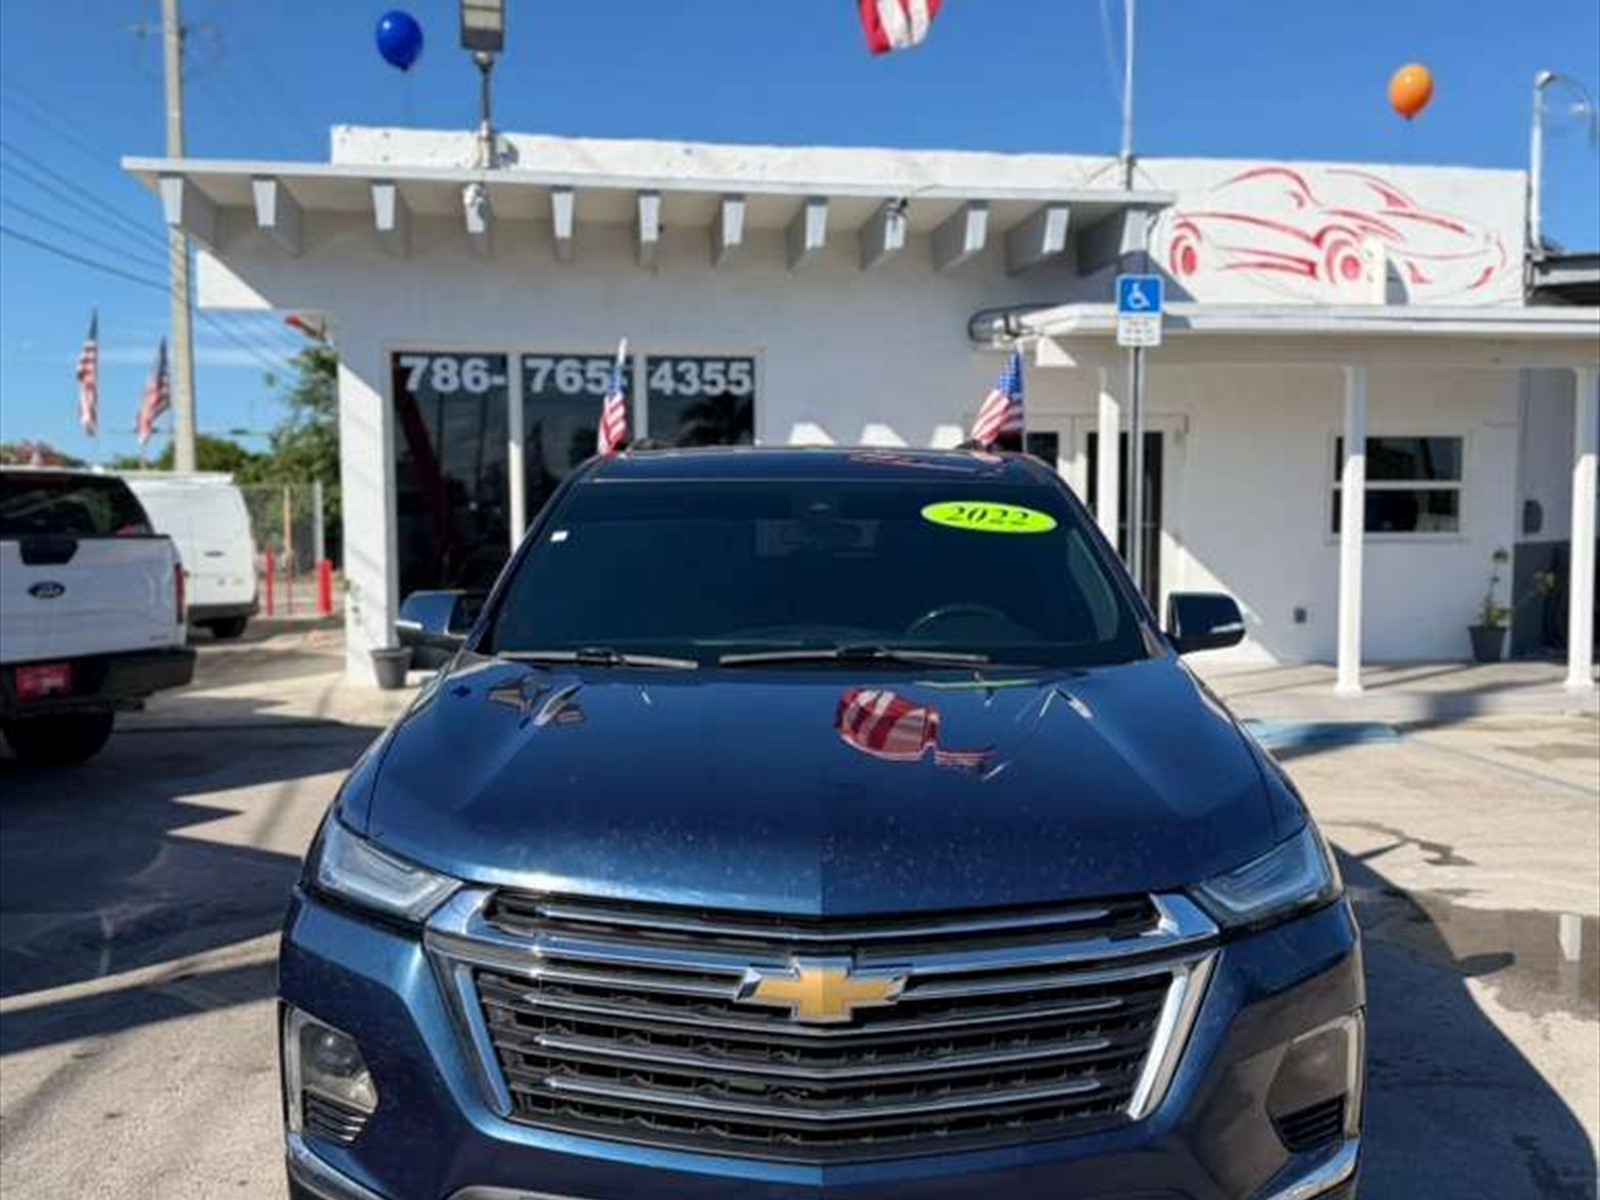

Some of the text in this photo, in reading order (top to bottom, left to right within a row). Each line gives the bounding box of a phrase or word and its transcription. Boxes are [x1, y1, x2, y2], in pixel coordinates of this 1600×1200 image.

[400, 356, 506, 393] 786-
[650, 361, 752, 396] 4355
[943, 505, 1030, 527] 2022
